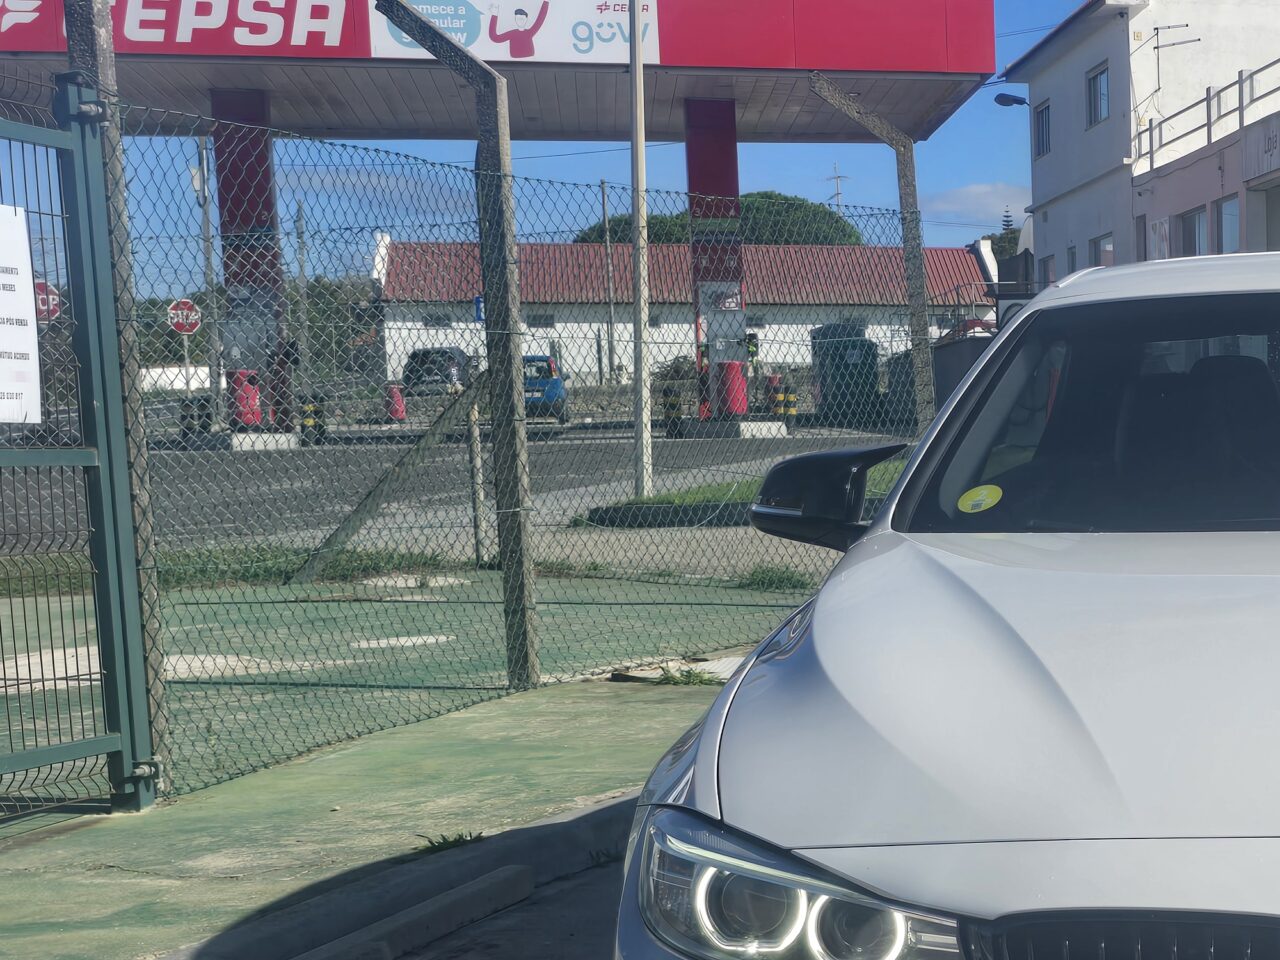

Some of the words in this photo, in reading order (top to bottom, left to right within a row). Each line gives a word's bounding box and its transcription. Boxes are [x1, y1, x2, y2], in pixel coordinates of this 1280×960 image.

[62, 0, 347, 46] EPSA
[458, 6, 466, 15] a
[1264, 130, 1278, 157] Loja
